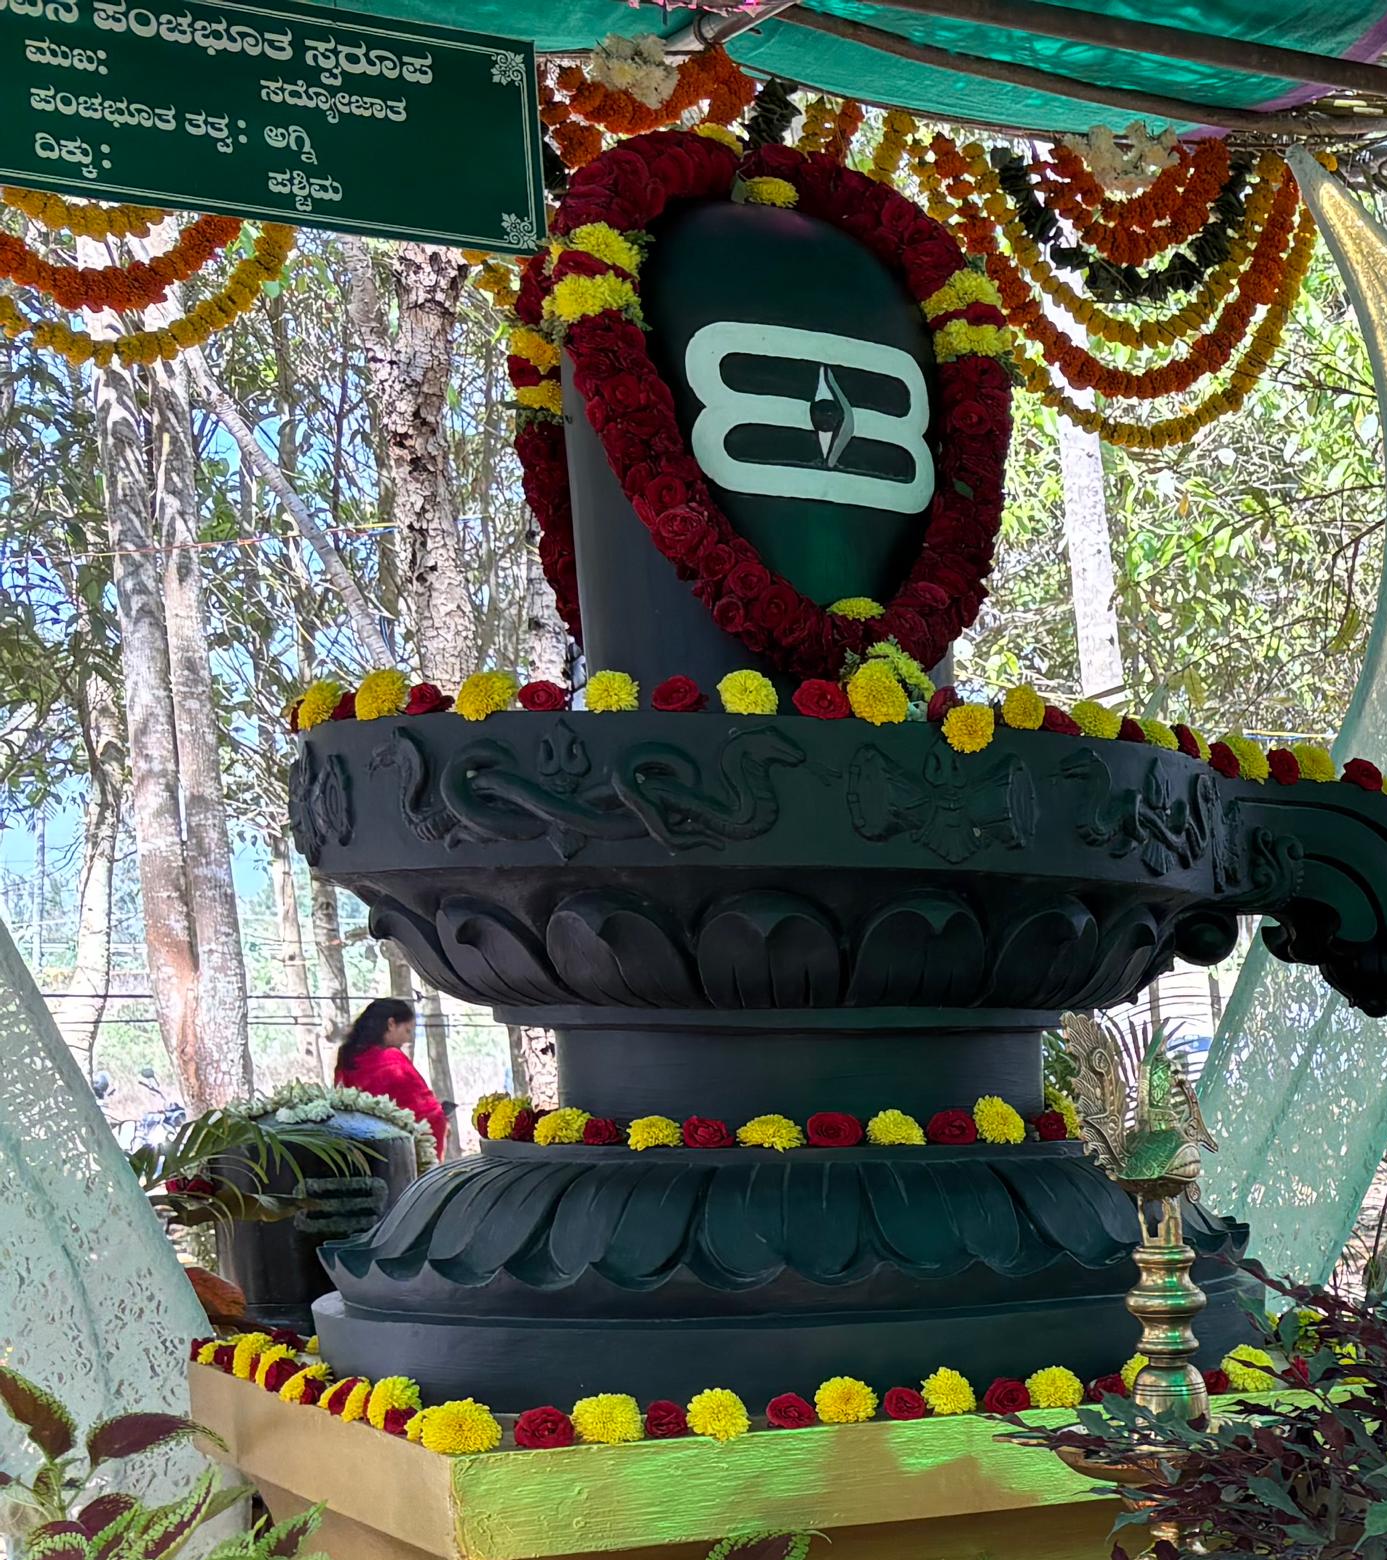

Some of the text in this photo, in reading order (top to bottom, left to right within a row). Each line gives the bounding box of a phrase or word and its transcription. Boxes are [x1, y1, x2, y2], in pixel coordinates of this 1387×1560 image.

[304, 34, 433, 86] ಸ್ವರೂಪ
[30, 84, 177, 129] ಪಂಚಭೂತ
[263, 124, 319, 166] ಅಗ್ನಿ
